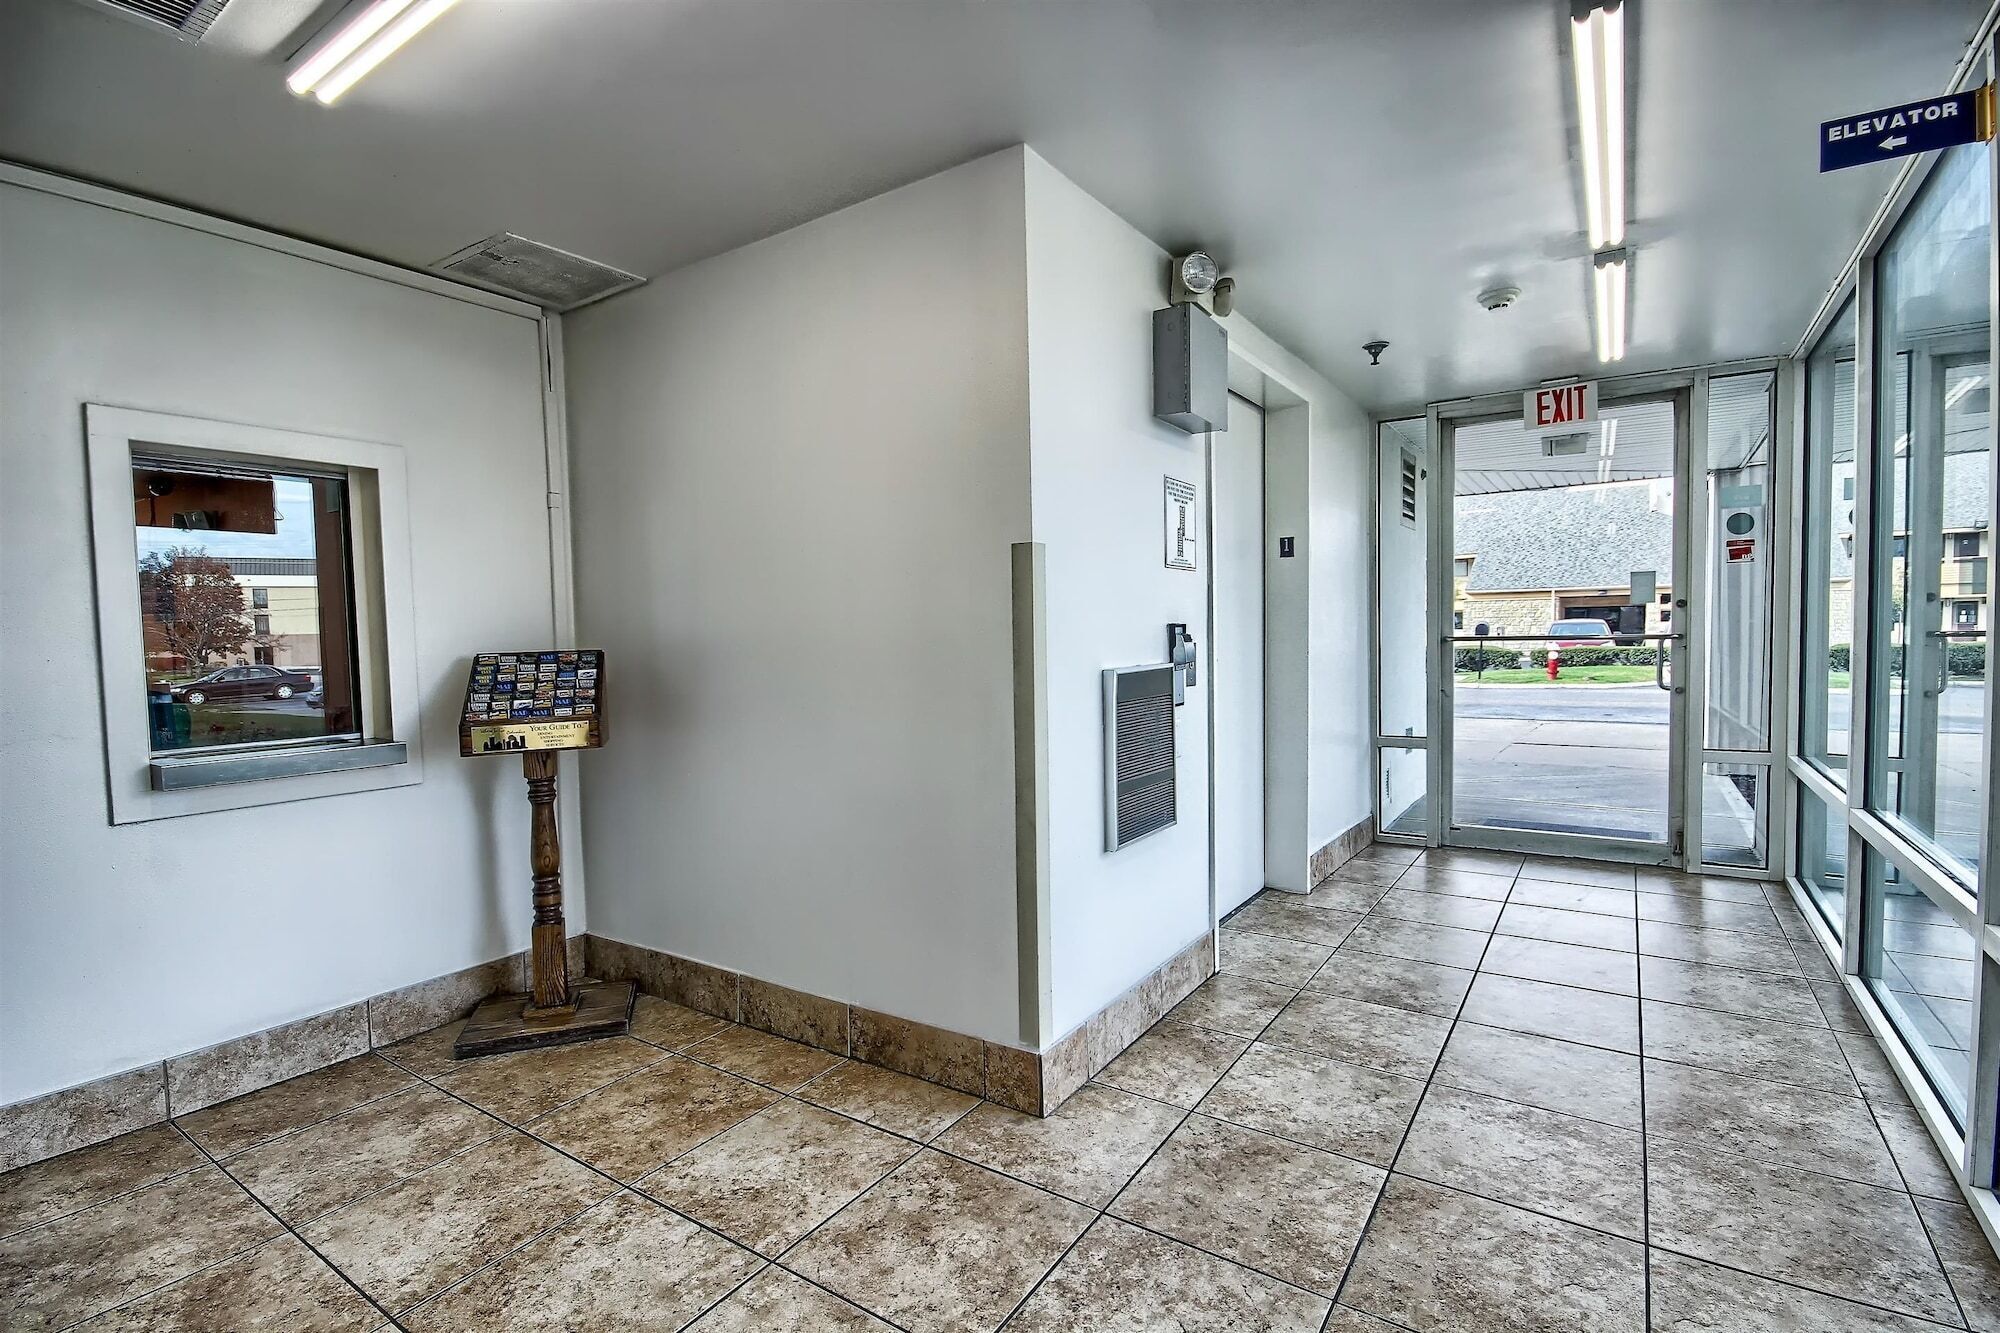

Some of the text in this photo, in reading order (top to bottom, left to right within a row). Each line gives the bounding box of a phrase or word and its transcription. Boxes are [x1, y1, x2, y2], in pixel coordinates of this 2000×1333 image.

[1828, 102, 1959, 142] ELEVATOR
[1536, 385, 1587, 426] EXIT
[1284, 539, 1289, 551] 1
